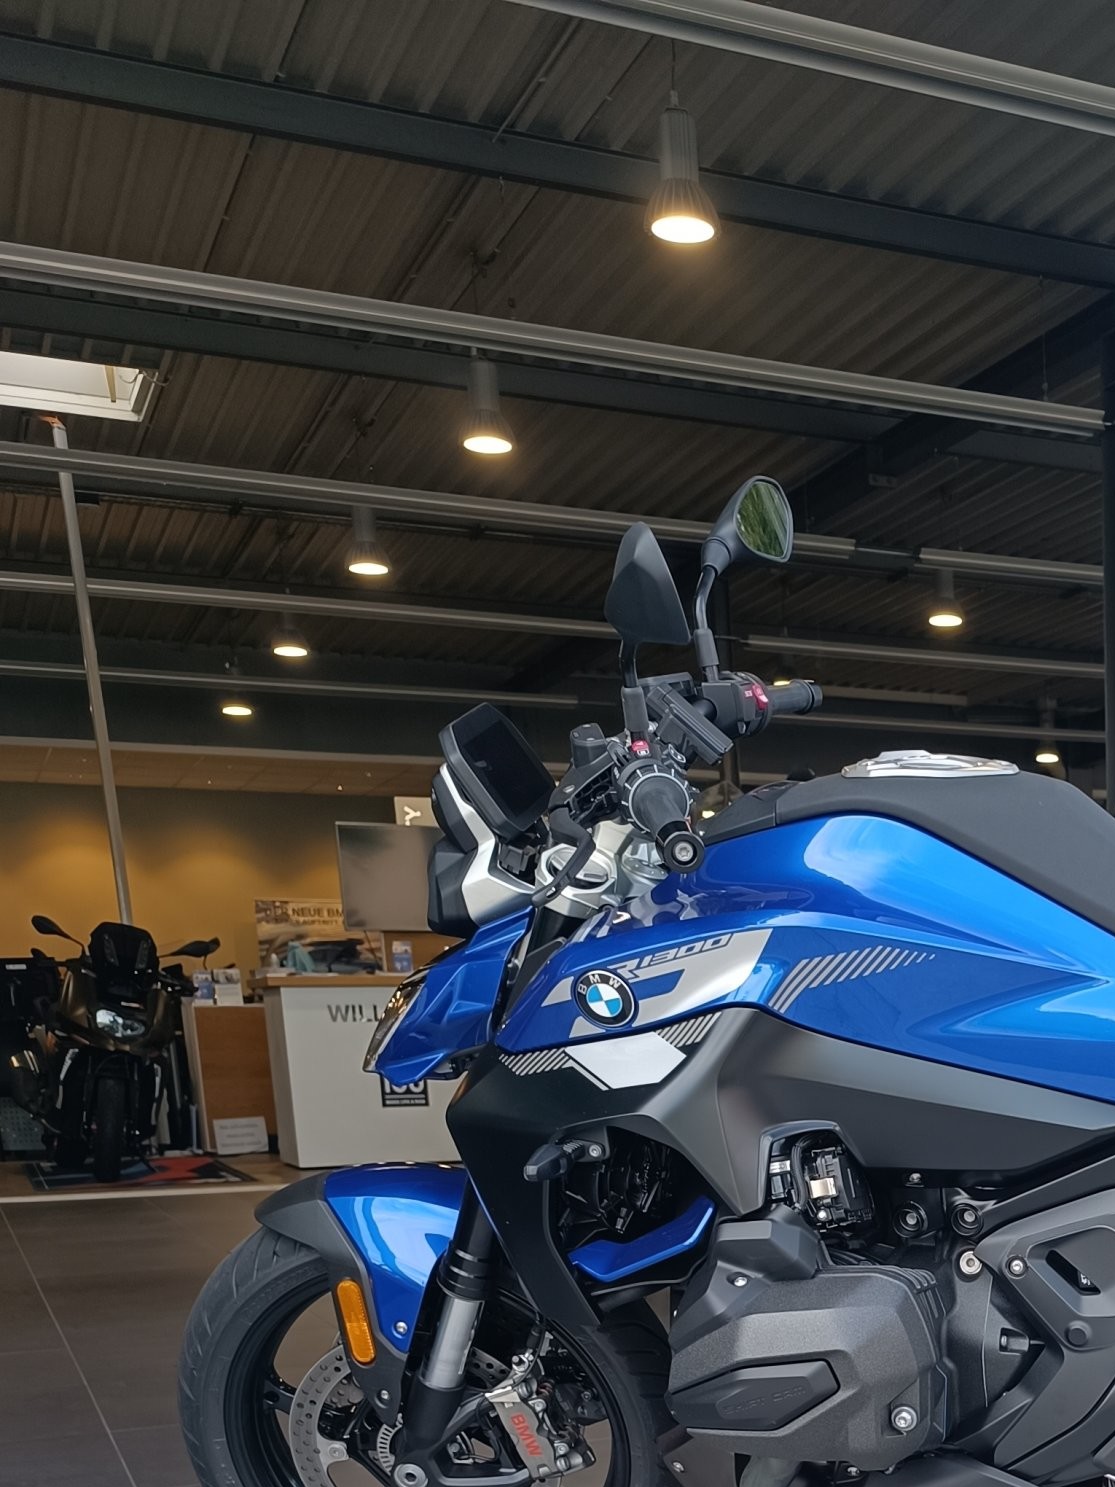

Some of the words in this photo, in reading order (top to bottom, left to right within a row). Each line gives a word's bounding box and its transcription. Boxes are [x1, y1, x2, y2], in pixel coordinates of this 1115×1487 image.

[292, 907, 324, 917] NEUE
[578, 973, 621, 994] BMW
[511, 1413, 543, 1457] BMW
